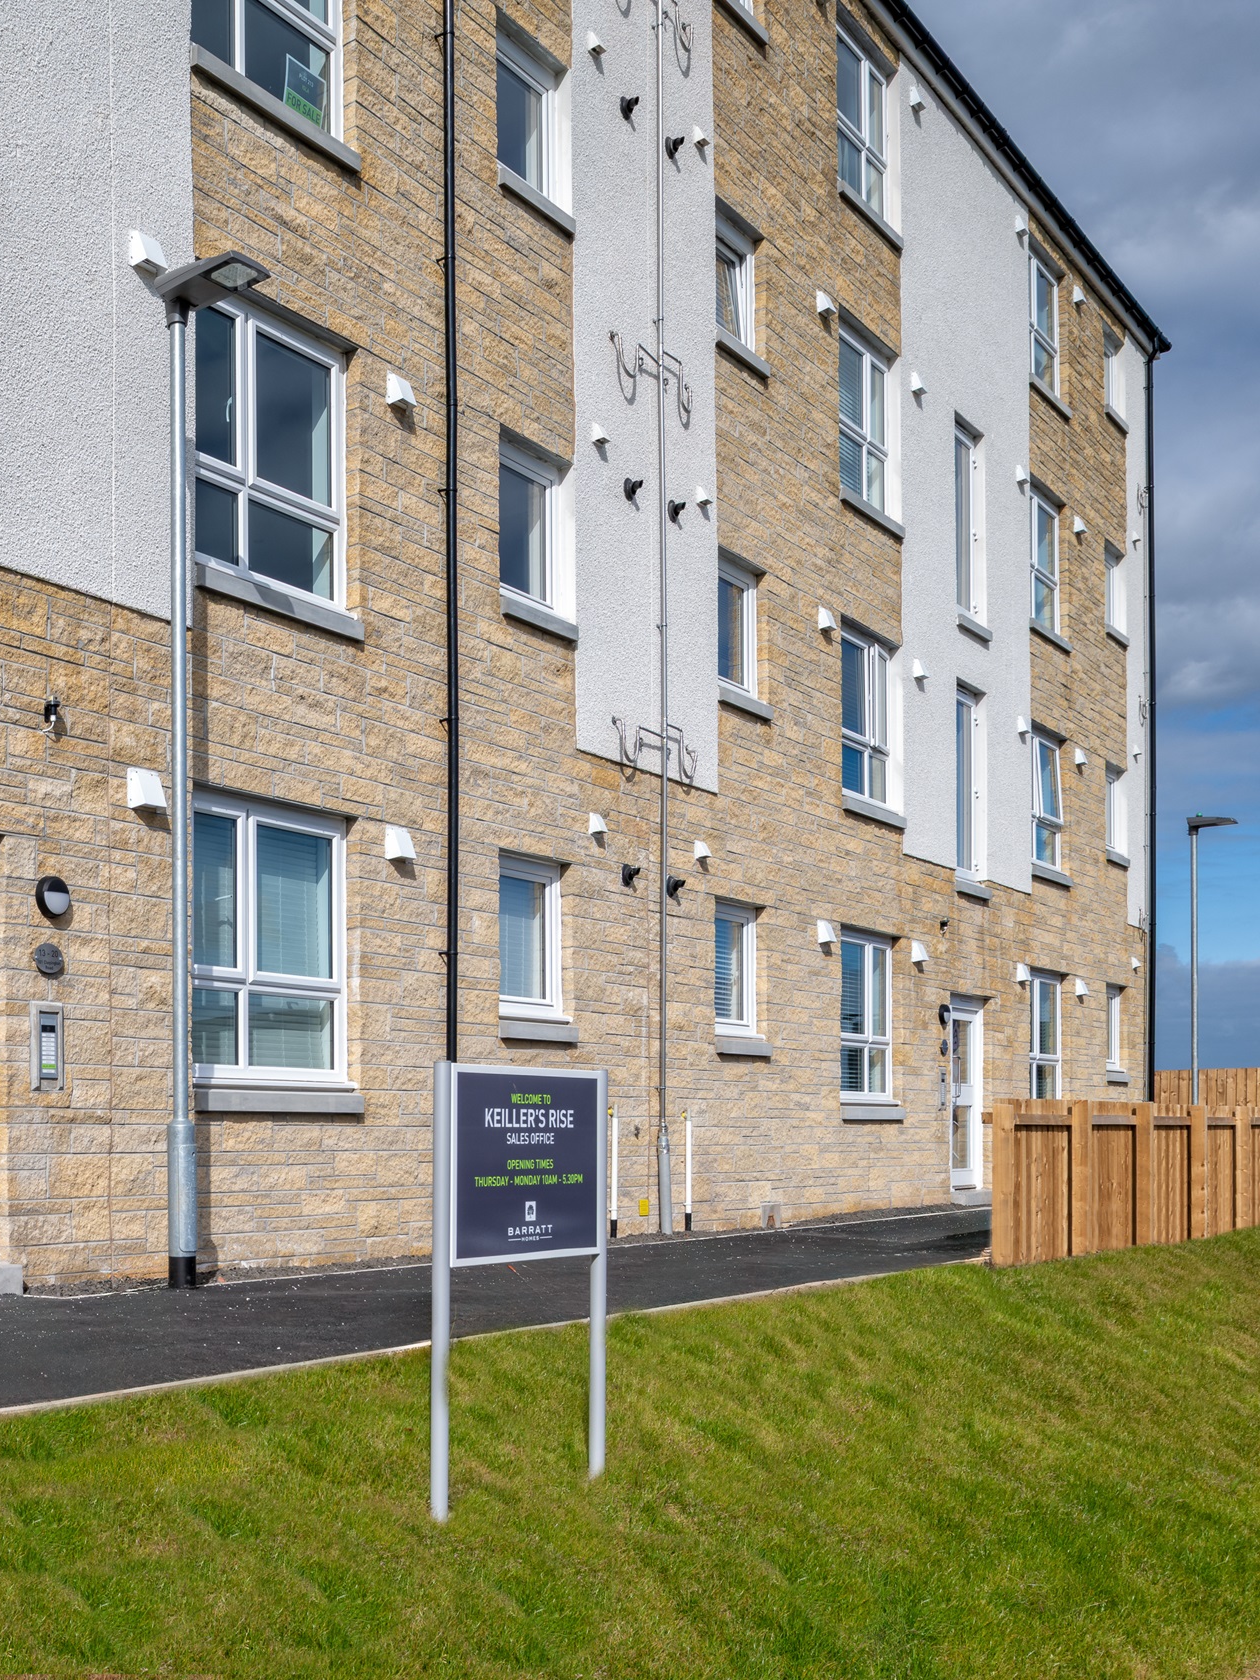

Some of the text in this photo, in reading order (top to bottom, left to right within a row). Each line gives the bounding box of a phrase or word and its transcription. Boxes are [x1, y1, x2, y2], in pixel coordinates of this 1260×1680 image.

[286, 92, 320, 123] FOR SALE
[510, 1093, 551, 1104] WELCOME TO
[484, 1108, 574, 1128] KEILLER'S RISE
[506, 1133, 555, 1144] SALES OFFICE
[507, 1159, 554, 1170] OPENING TIMES
[474, 1176, 509, 1187] THURSDAY
[514, 1175, 540, 1186] MONDAY
[542, 1174, 557, 1185] 10AM
[562, 1174, 583, 1184] 5.30PM
[507, 1224, 553, 1236] BARRATT
